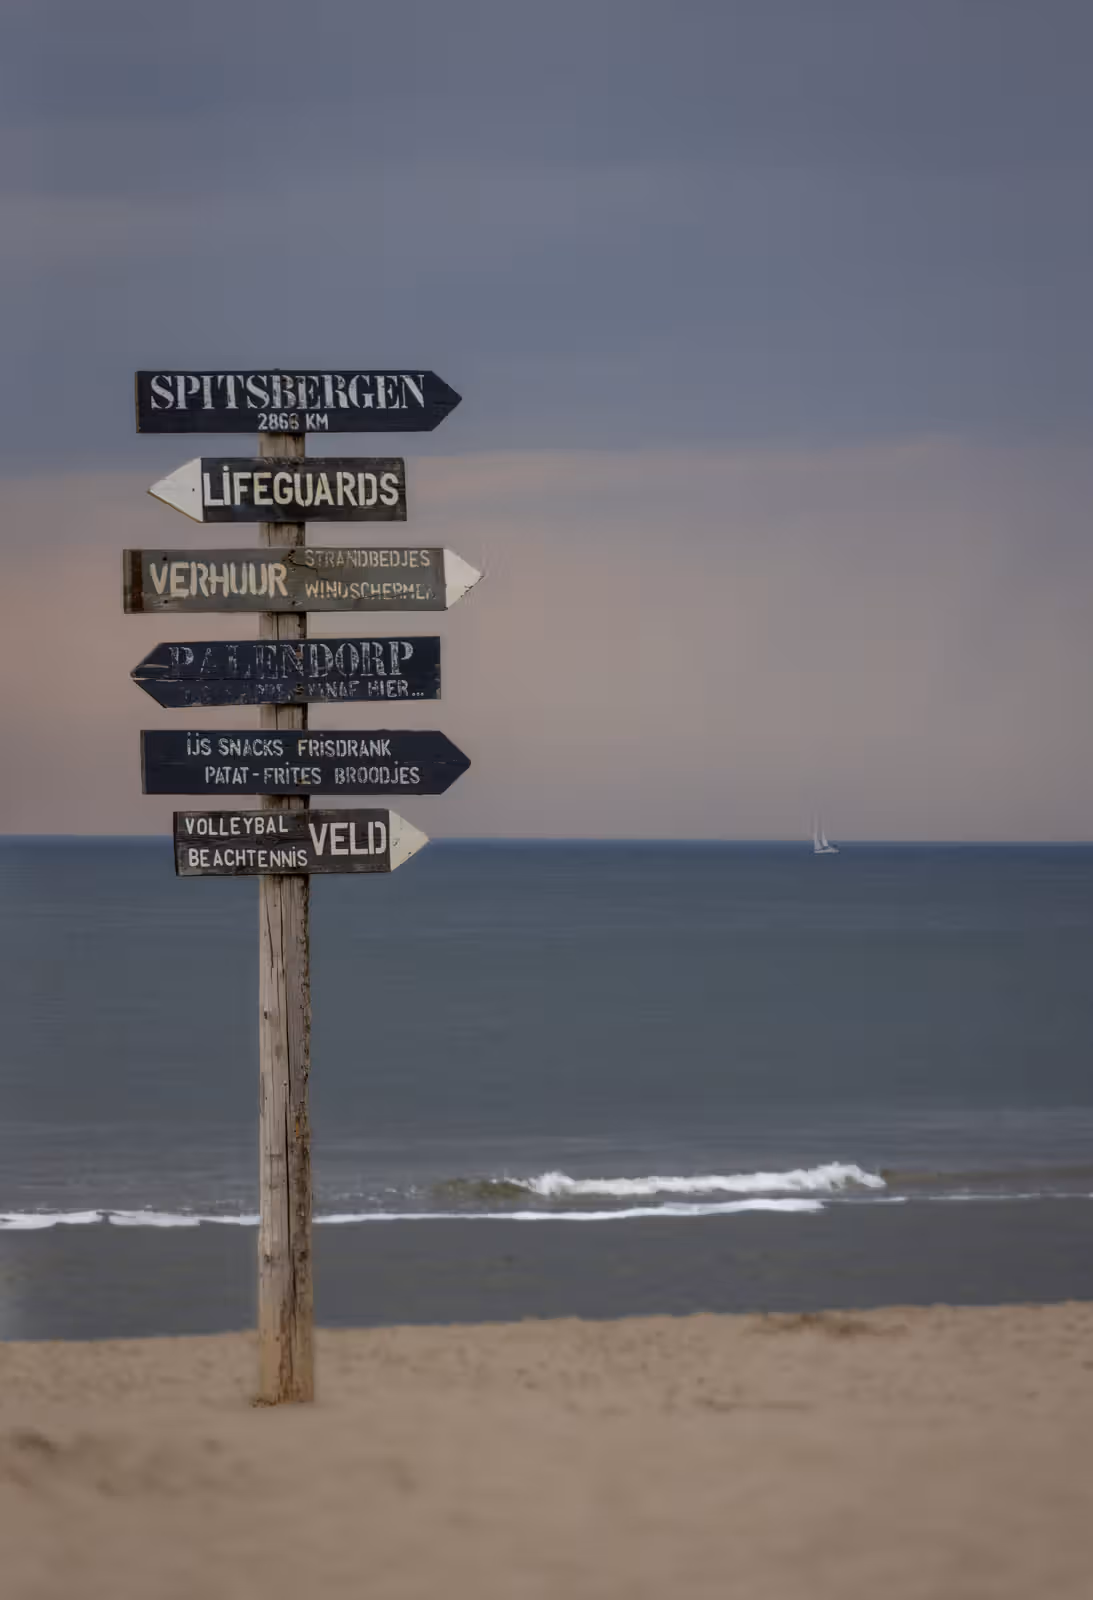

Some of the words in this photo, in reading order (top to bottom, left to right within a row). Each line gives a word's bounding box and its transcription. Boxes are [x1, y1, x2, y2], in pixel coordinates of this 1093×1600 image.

[150, 374, 425, 410] SPITSBERGEN
[306, 413, 329, 431] KM
[304, 550, 431, 568] STRANDBEDJES
[150, 561, 288, 598] VERHUUR
[218, 738, 284, 757] SNACKS
[185, 815, 289, 836] VOLLEYBAL
[308, 821, 387, 856] VELD
